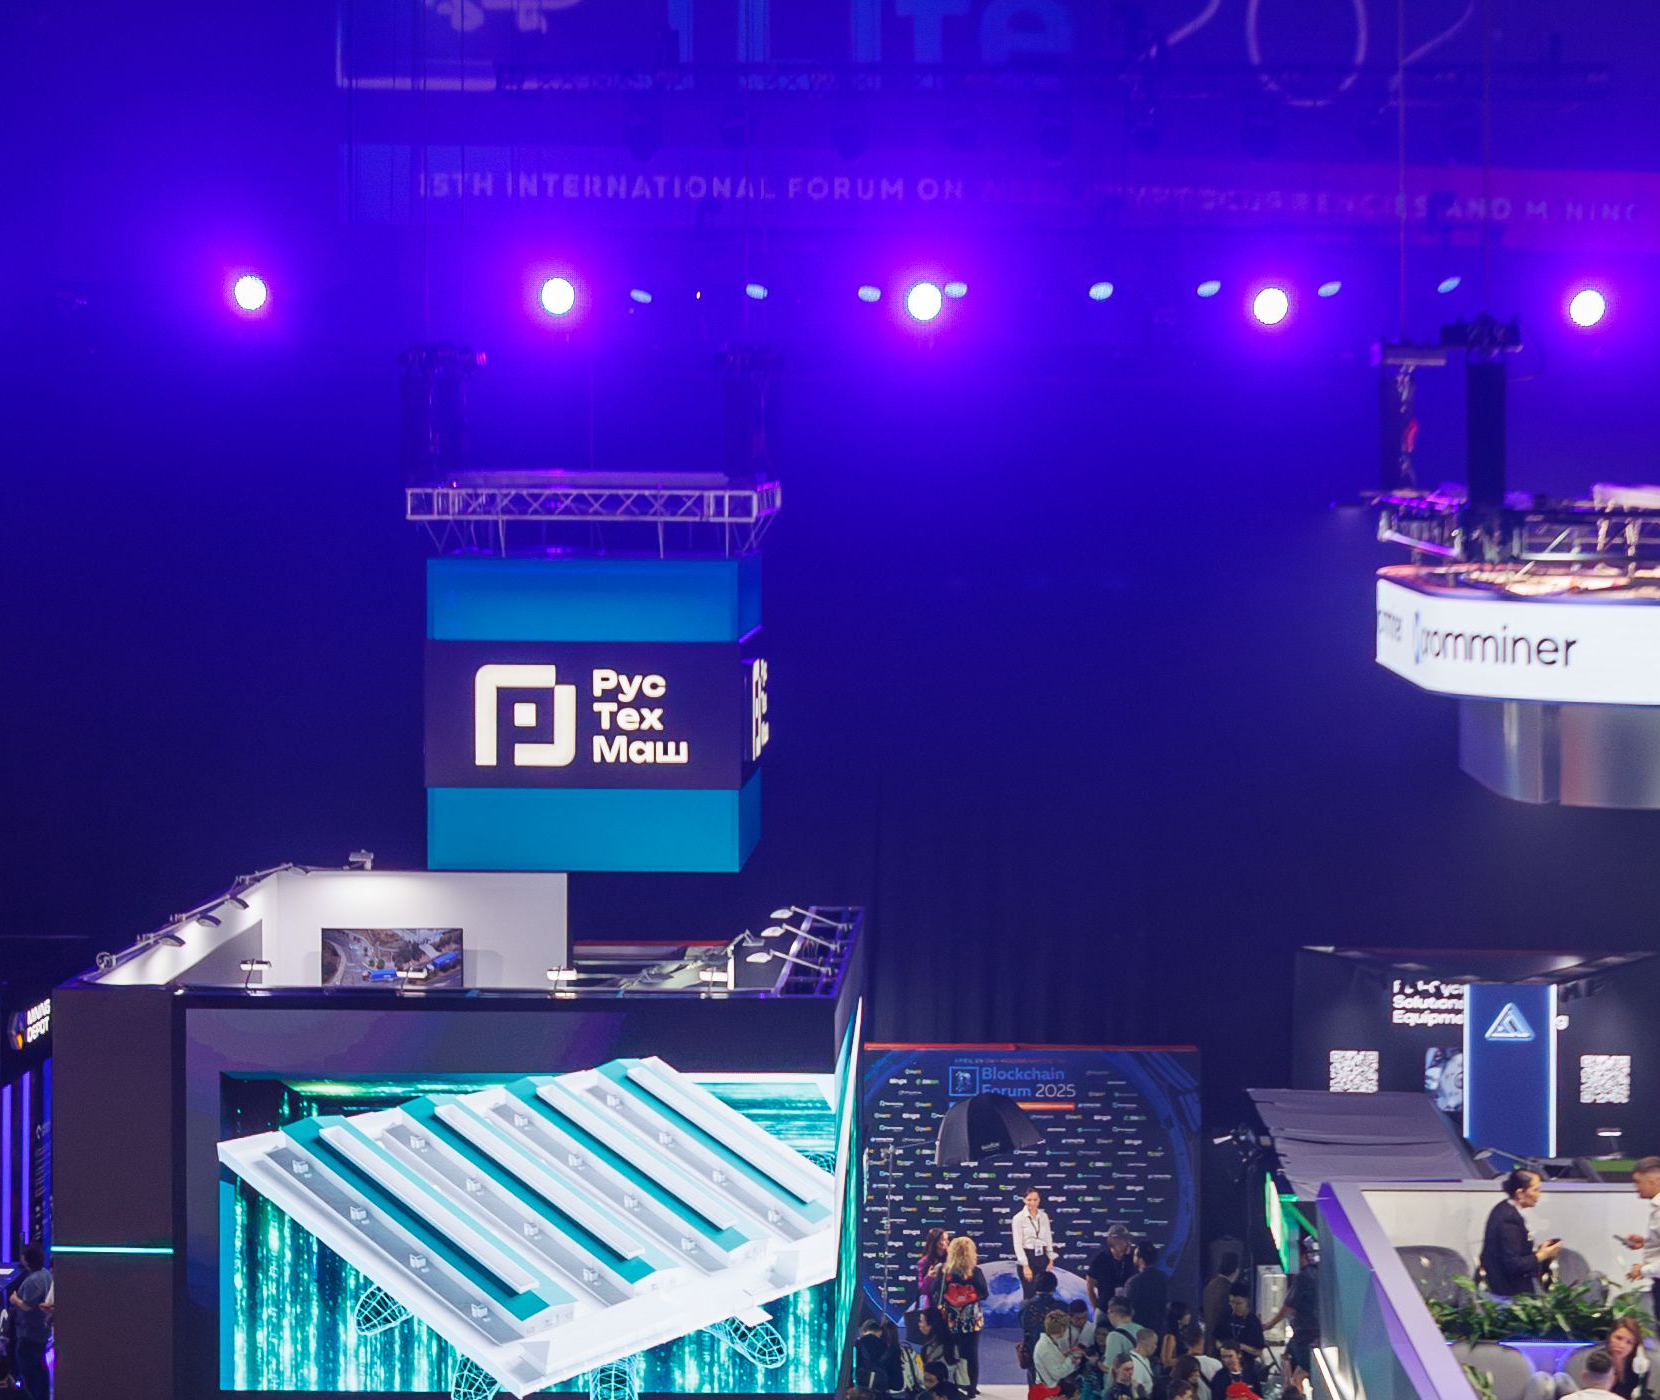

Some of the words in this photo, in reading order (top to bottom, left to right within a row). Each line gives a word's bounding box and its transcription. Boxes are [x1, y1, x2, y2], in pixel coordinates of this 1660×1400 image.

[506, 173, 776, 201] INTERNATIONAL
[787, 175, 903, 201] FORUM
[916, 176, 964, 201] ON
[1525, 199, 1640, 222] MNIN
[592, 668, 668, 703] Рус
[592, 702, 665, 731] Тех
[592, 735, 689, 764] Маш
[1393, 995, 1464, 1010] Solution
[982, 1067, 1065, 1081] Blockchain
[982, 1084, 1032, 1098] Forum
[1035, 1083, 1077, 1098] 2025
